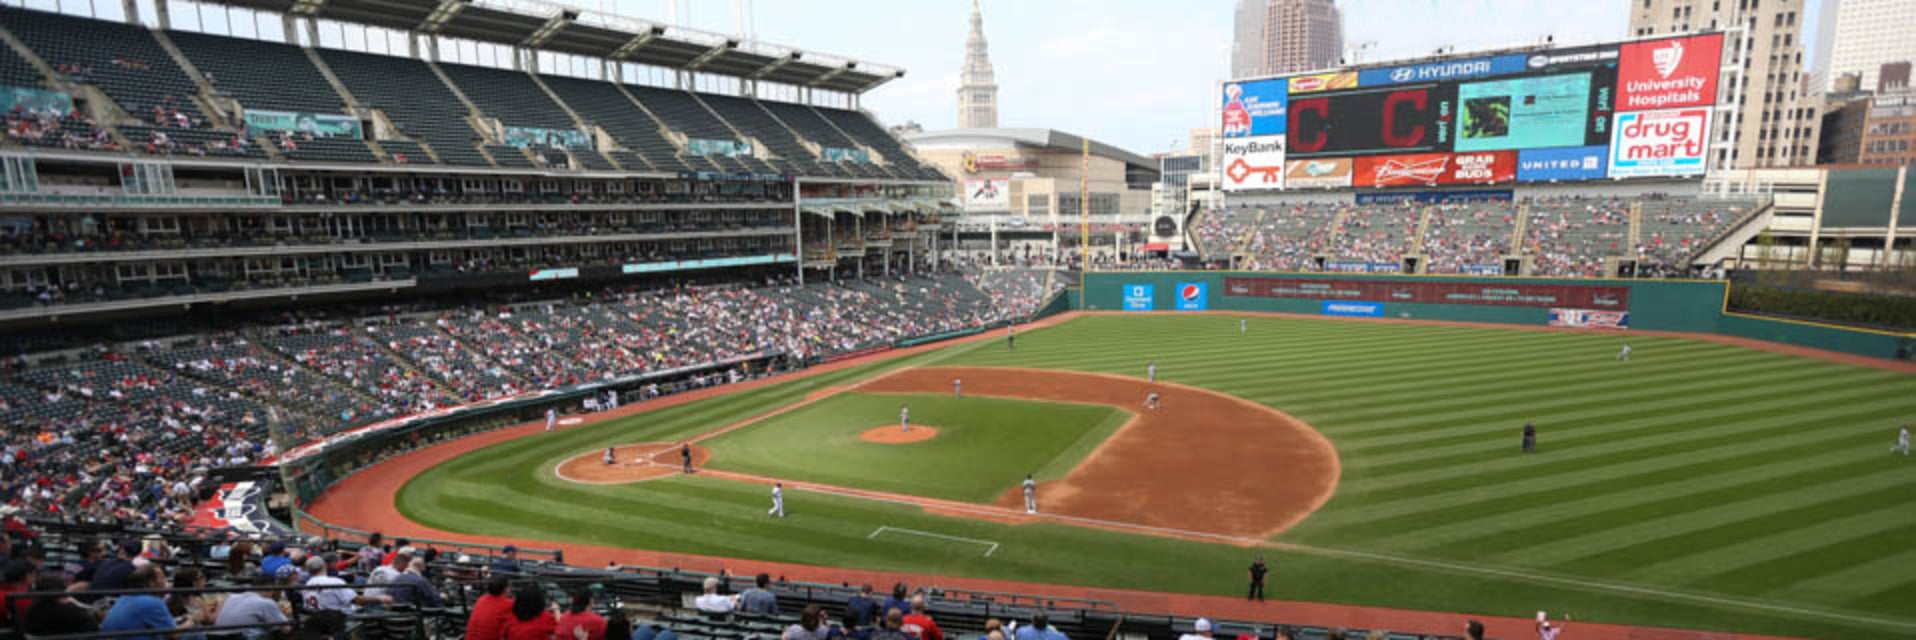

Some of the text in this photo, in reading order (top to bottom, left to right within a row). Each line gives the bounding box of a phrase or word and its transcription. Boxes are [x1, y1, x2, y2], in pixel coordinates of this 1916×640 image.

[1419, 61, 1491, 79] HYUNDAI
[1626, 76, 1707, 93] University
[1628, 90, 1700, 107] Hospitals
[1288, 97, 1328, 153] C
[1382, 89, 1428, 147] C
[1624, 113, 1690, 142] drug
[1225, 140, 1283, 156] KeyBank
[1628, 139, 1702, 159] mart
[1522, 160, 1580, 170] UNITED
